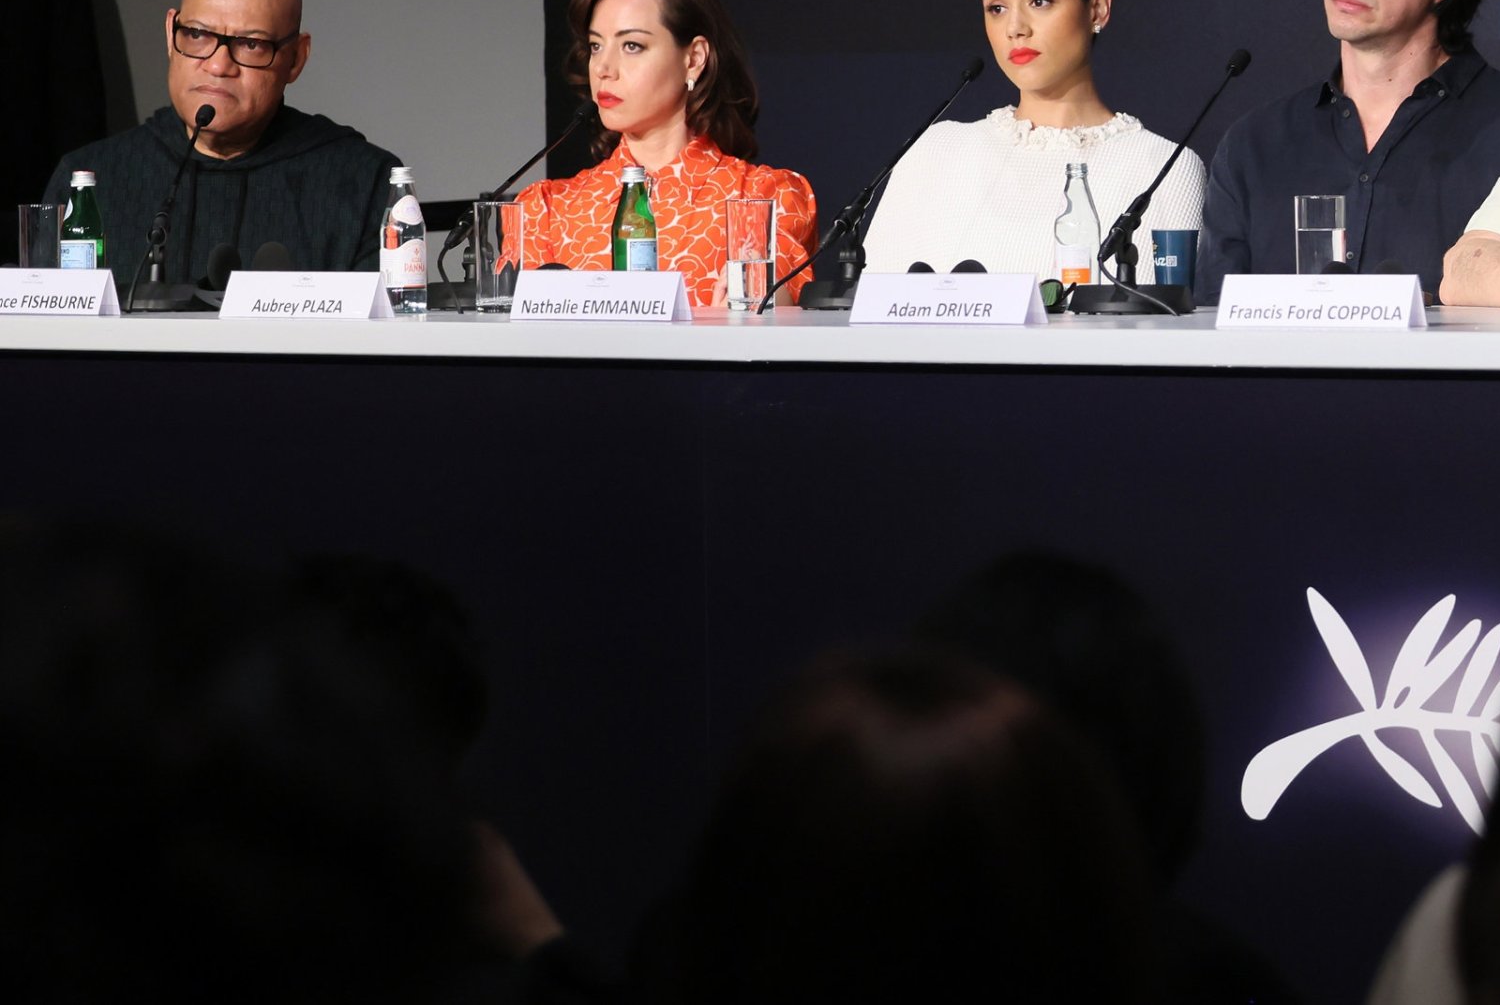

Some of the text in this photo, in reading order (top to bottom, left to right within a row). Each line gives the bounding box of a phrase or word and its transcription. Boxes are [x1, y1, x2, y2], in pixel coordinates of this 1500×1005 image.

[20, 295, 97, 310] FISHBURNE
[251, 298, 343, 317] Aubrey PLAZA
[520, 298, 667, 316] Nathalie EMMANUEL
[887, 302, 993, 318] Adam DRIVER
[1229, 304, 1402, 321] Francis Ford COPPOLA
